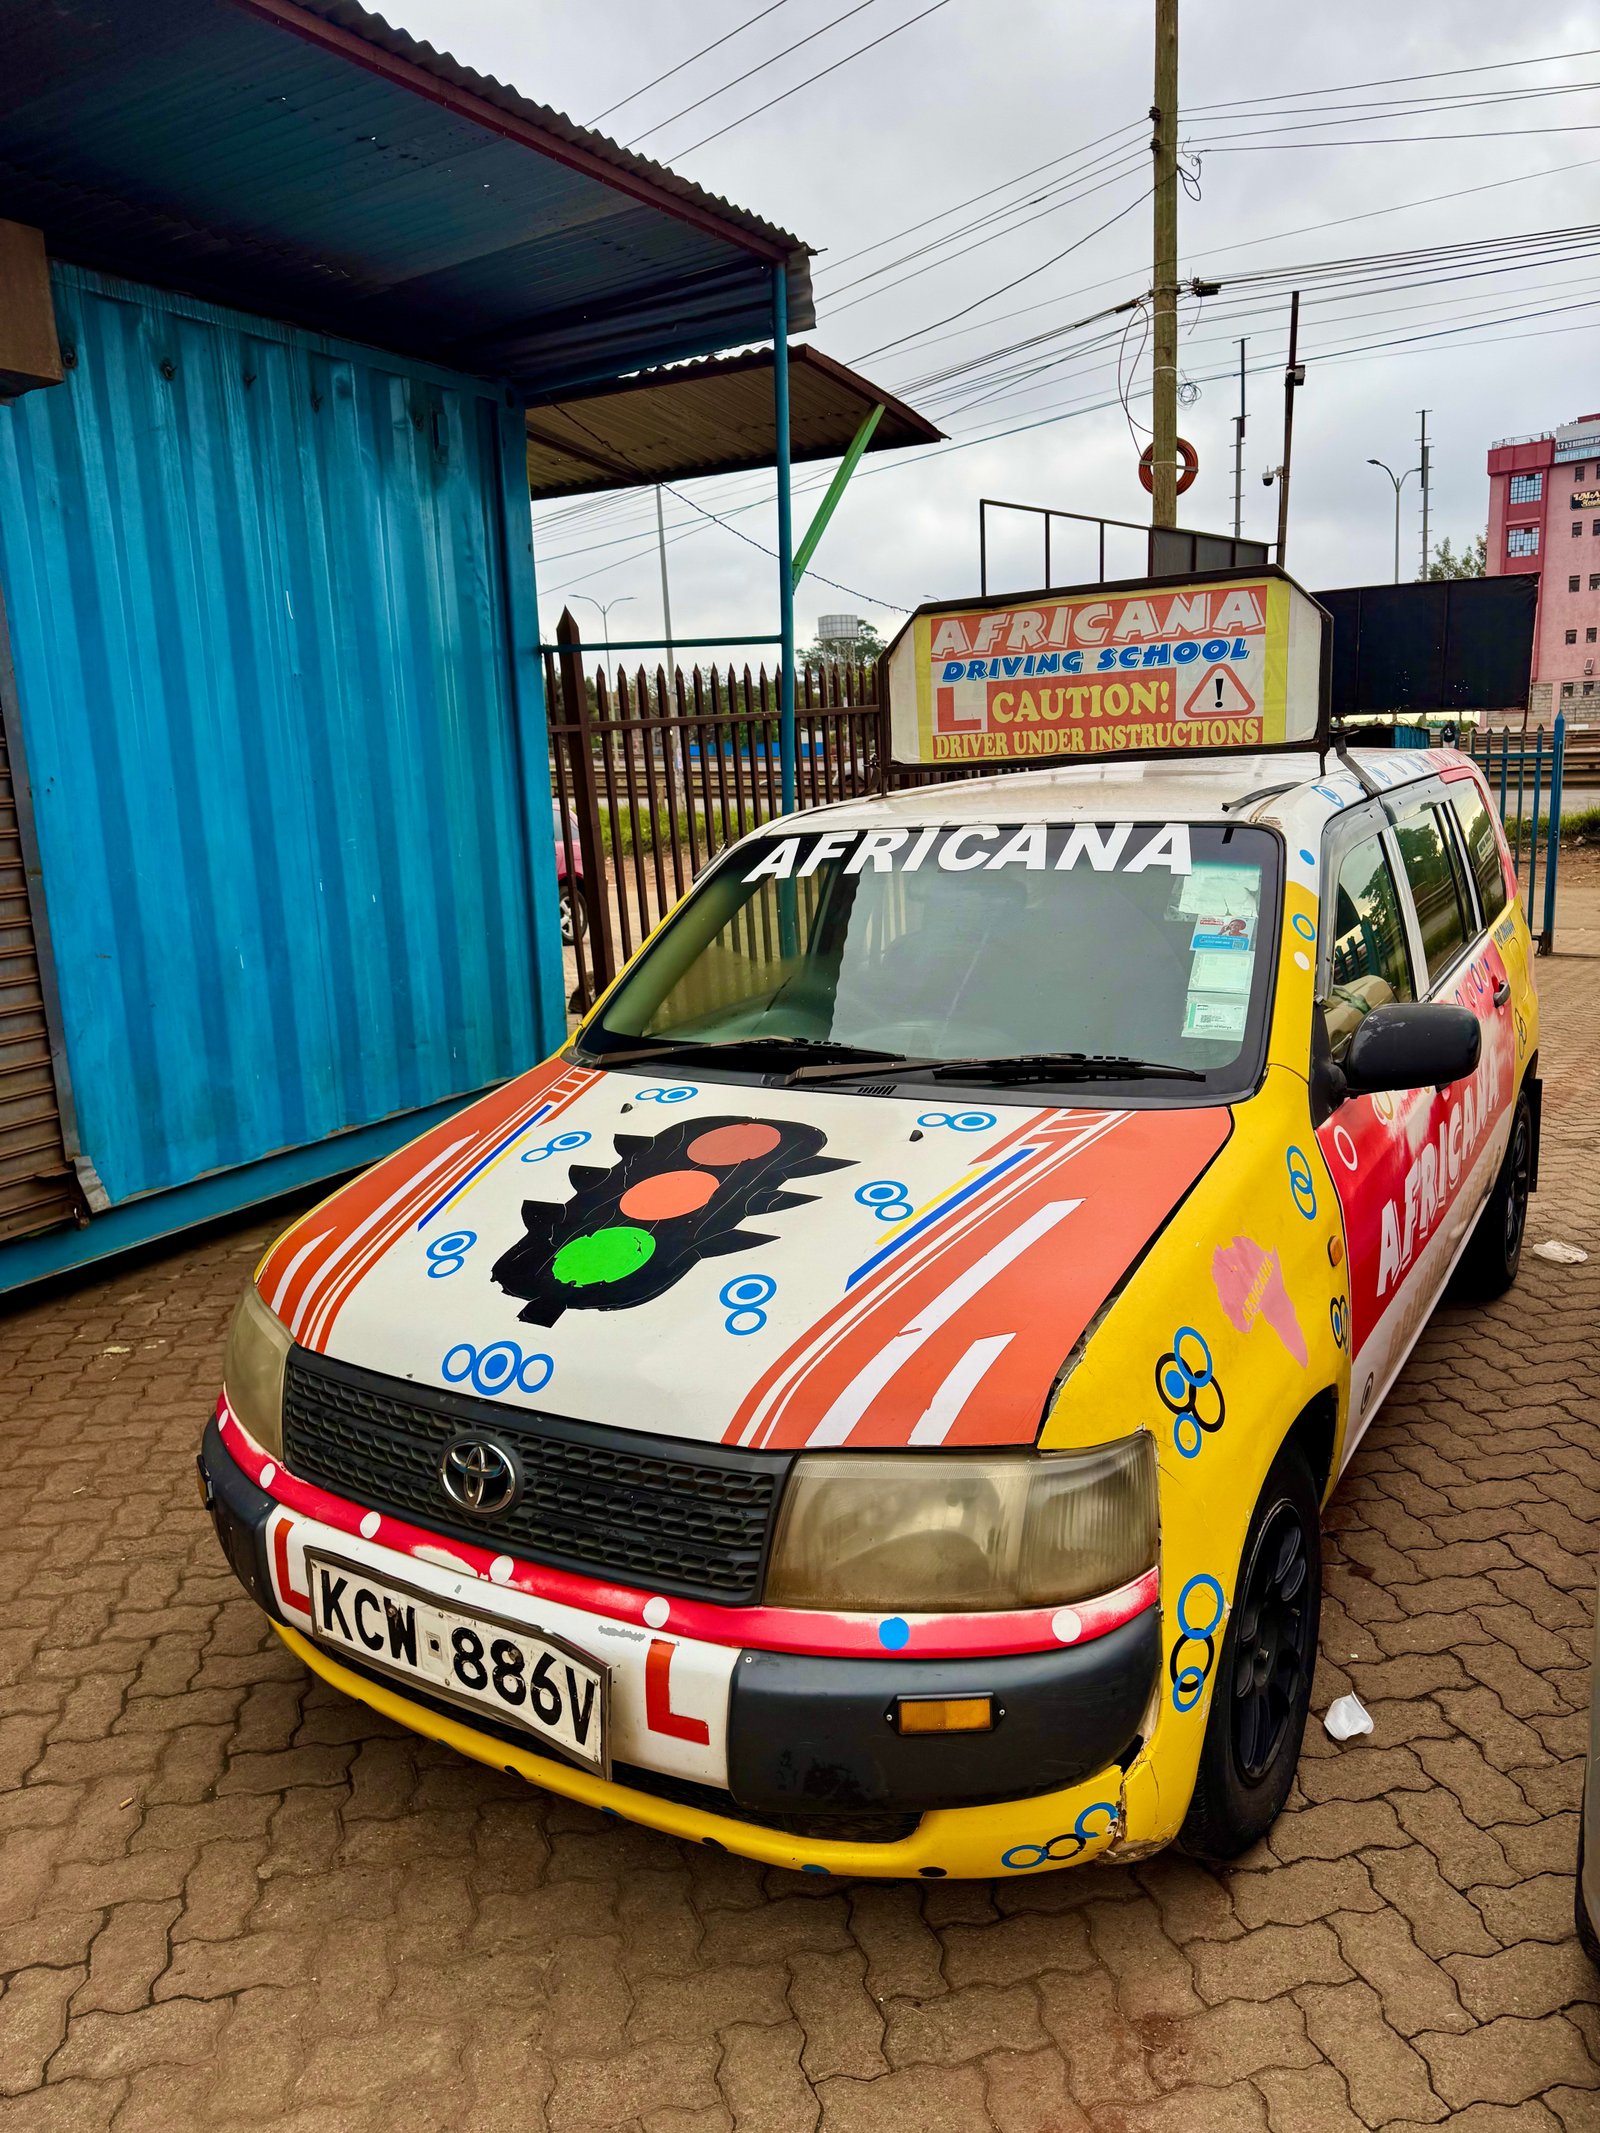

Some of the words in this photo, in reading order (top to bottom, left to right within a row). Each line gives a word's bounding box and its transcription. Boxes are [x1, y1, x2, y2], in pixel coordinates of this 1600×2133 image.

[931, 590, 1266, 657] AFRICANA
[942, 650, 1084, 683] DRIVING
[1097, 637, 1251, 670] SCHOOL
[936, 687, 982, 733] L
[992, 681, 1170, 723] CAUTION!
[936, 732, 1009, 759] DRIVER
[1013, 727, 1085, 756] UNDER
[1090, 718, 1259, 750] INSTRUCTIONS
[741, 822, 1192, 883] AFRICANA
[1376, 1046, 1500, 1297] AFRICANA
[274, 1517, 311, 1616] L
[321, 1569, 418, 1667] KCW
[451, 1626, 596, 1746] 886V
[645, 1638, 710, 1746] L
